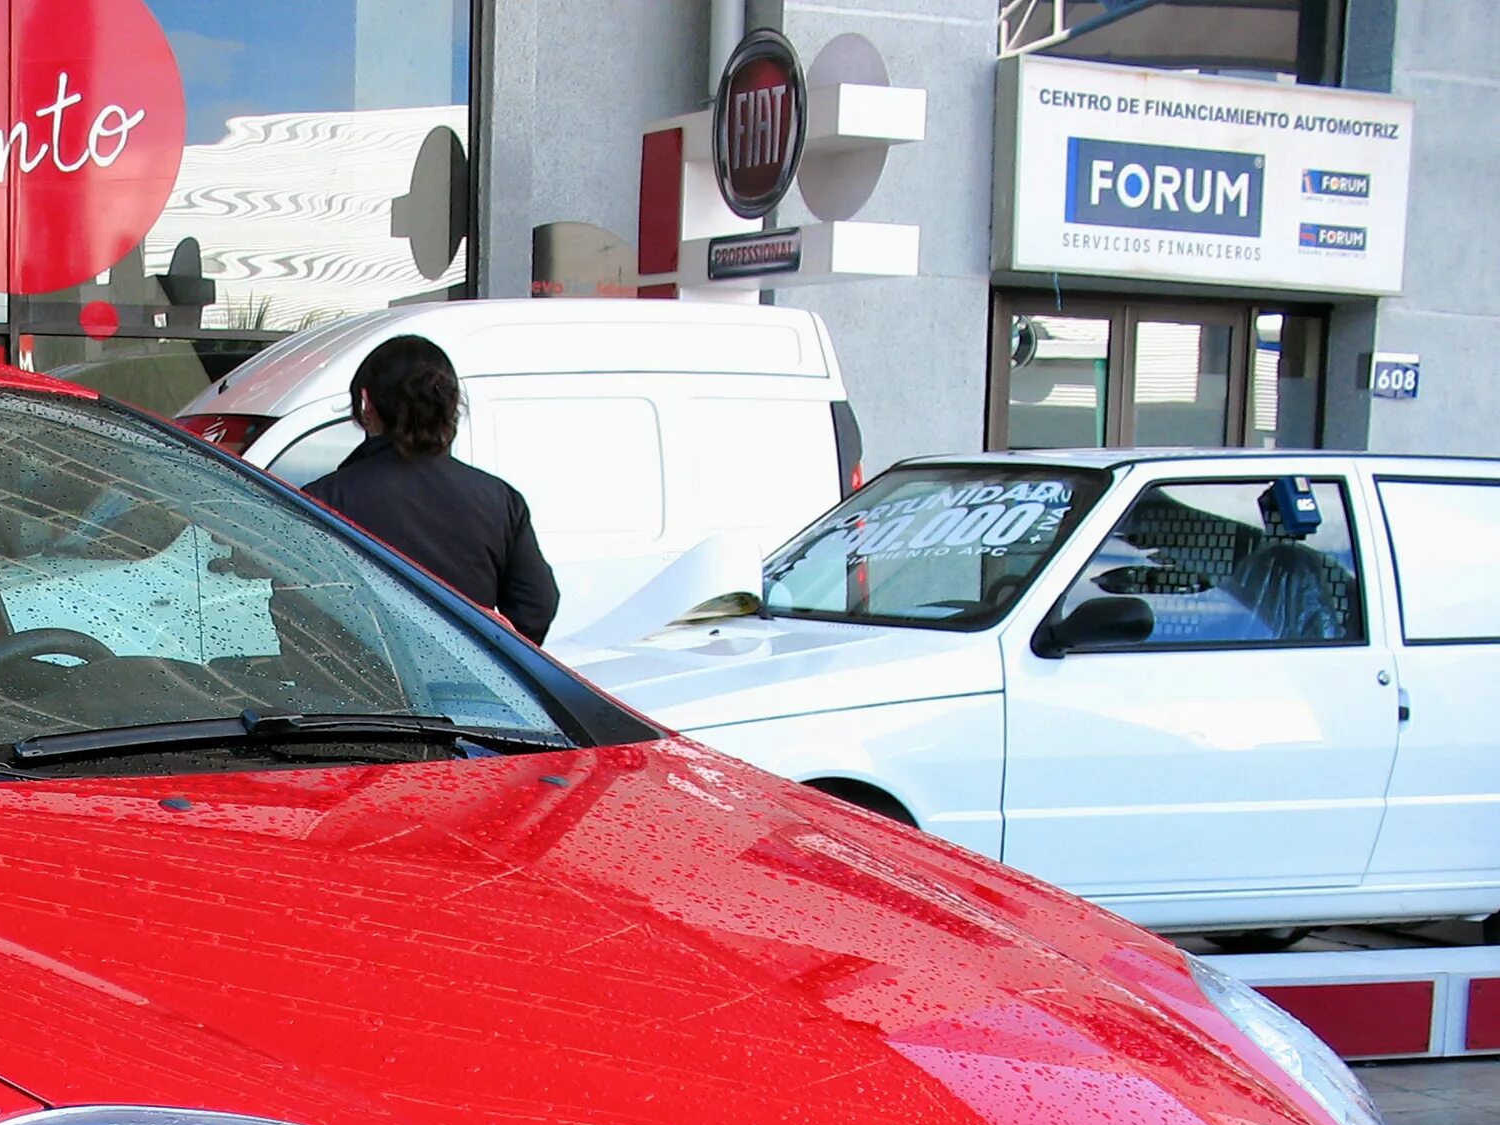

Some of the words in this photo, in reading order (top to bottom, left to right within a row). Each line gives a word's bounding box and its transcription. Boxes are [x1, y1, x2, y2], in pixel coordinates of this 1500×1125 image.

[733, 84, 787, 170] FIAT
[1038, 88, 1112, 112] CENTRO
[1116, 97, 1140, 115] DE
[1143, 99, 1290, 129] FINANCIAMIENTO
[1293, 114, 1399, 140] AUTOMOTRIZ
[1090, 159, 1250, 217] FORUM
[1321, 175, 1367, 193] FORUM
[1062, 232, 1151, 254] SERVICIOS
[1157, 238, 1262, 262] FINANCIEROS
[1318, 229, 1364, 246] FORUM
[714, 240, 794, 267] PROFESSIONAL
[1378, 368, 1416, 391] 608
[957, 545, 1008, 557] APC
